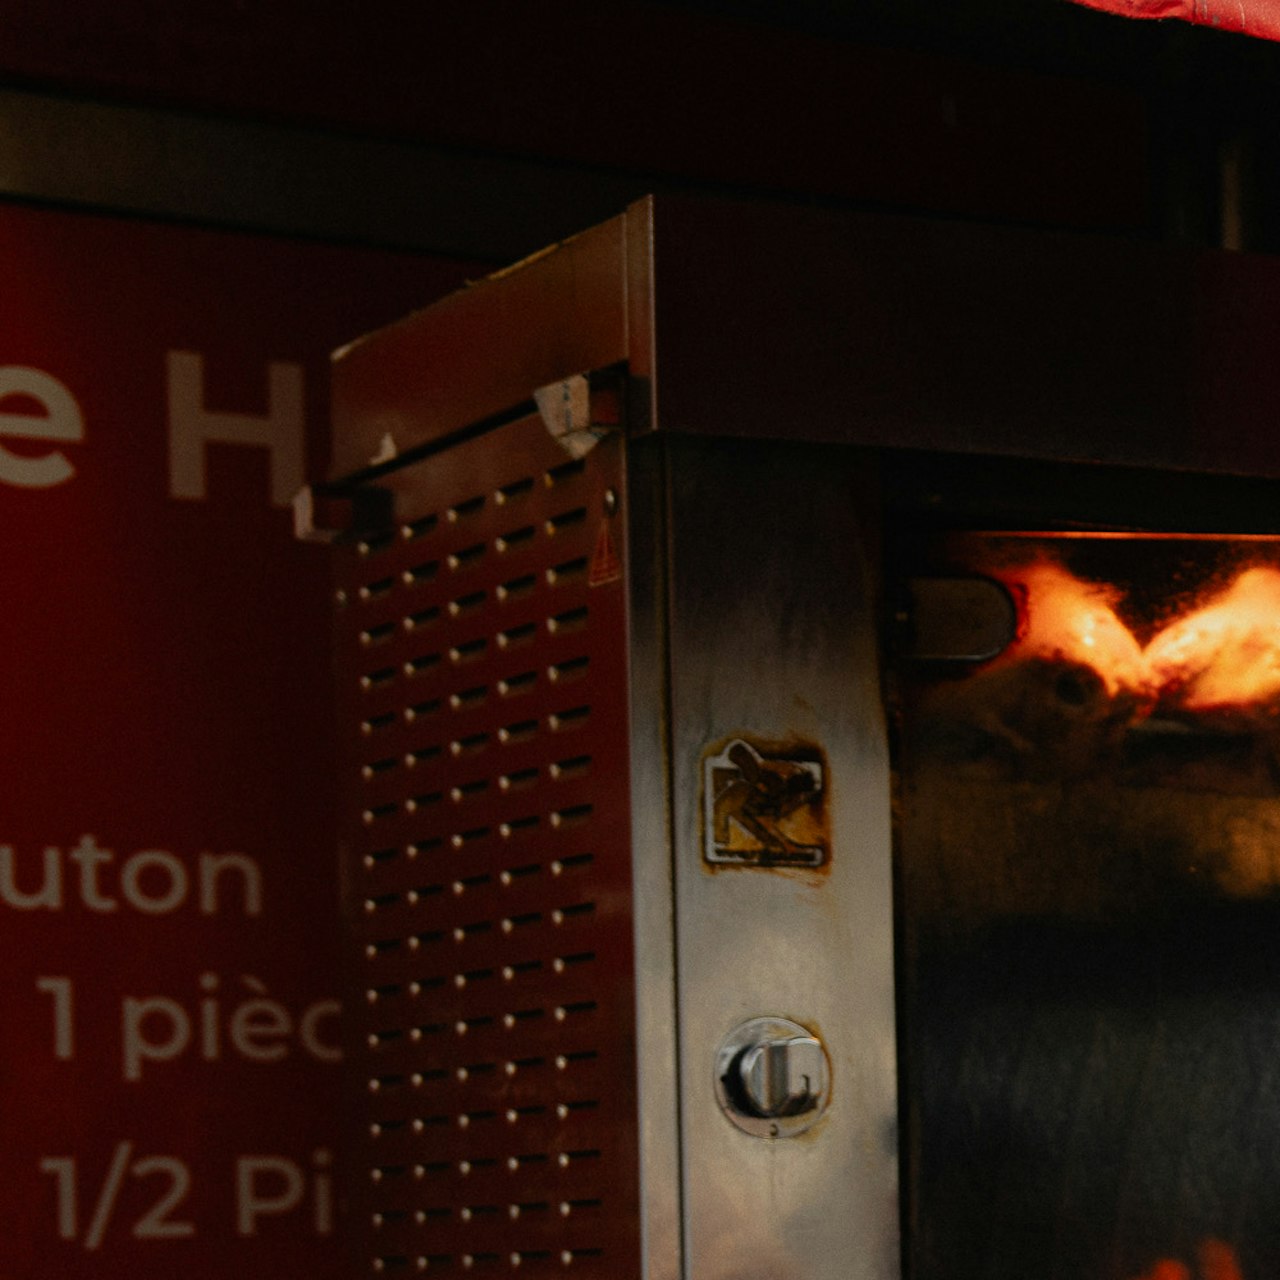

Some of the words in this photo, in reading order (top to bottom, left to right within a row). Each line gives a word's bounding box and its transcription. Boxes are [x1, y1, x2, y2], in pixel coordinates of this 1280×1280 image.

[0, 366, 83, 488] e
[167, 350, 304, 507] H
[0, 834, 262, 917] uton
[36, 976, 73, 1060] 1
[122, 972, 343, 1081] pièc
[41, 1141, 194, 1250] 1/2
[237, 1149, 333, 1235] Pi
